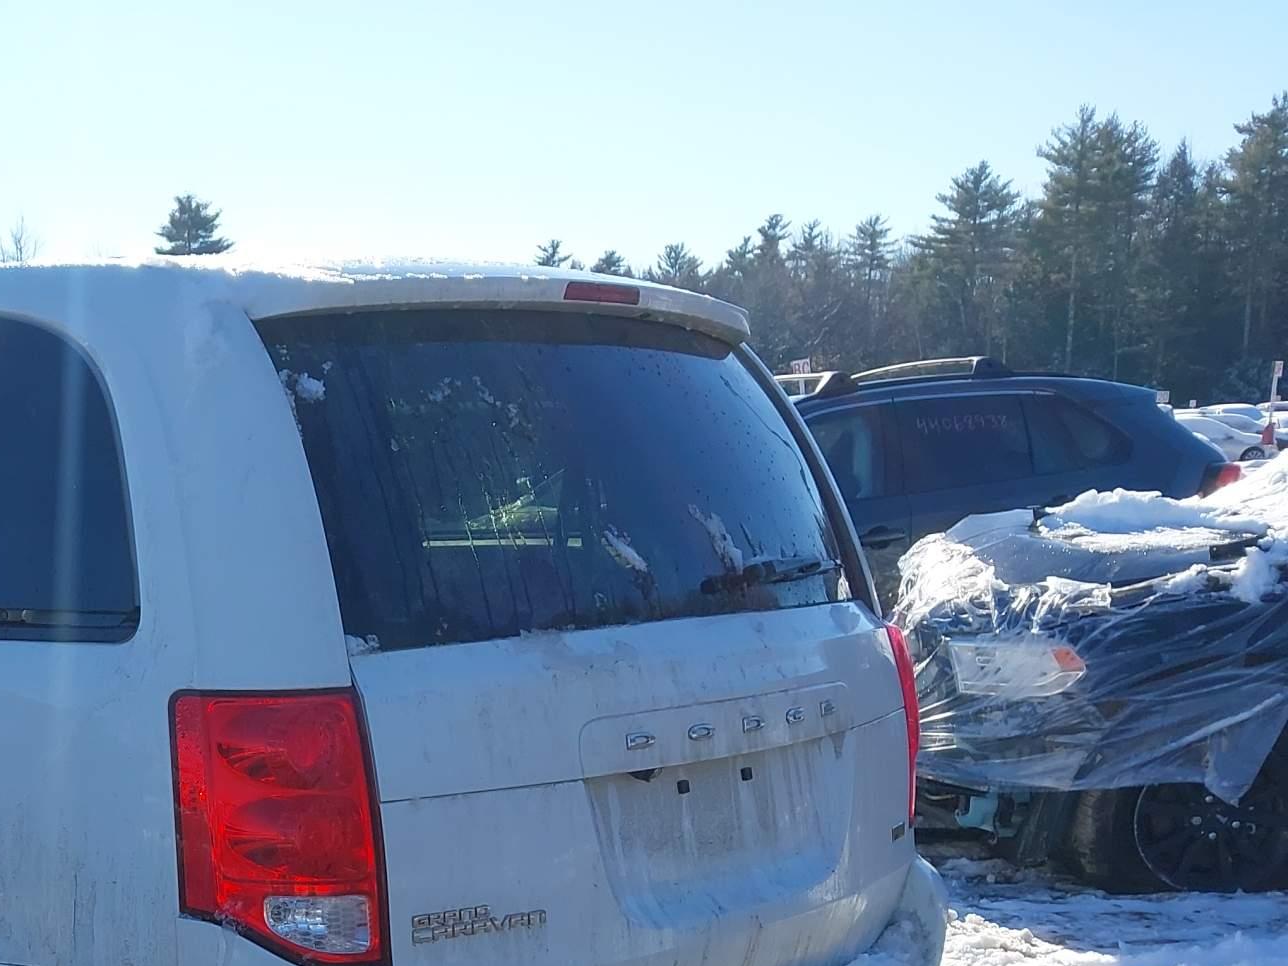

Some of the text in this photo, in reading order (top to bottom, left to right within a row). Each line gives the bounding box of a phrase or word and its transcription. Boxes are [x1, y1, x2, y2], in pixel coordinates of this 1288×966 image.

[625, 700, 837, 751] DODGE
[411, 904, 491, 928] GRAND
[411, 909, 547, 944] CARAVAN
